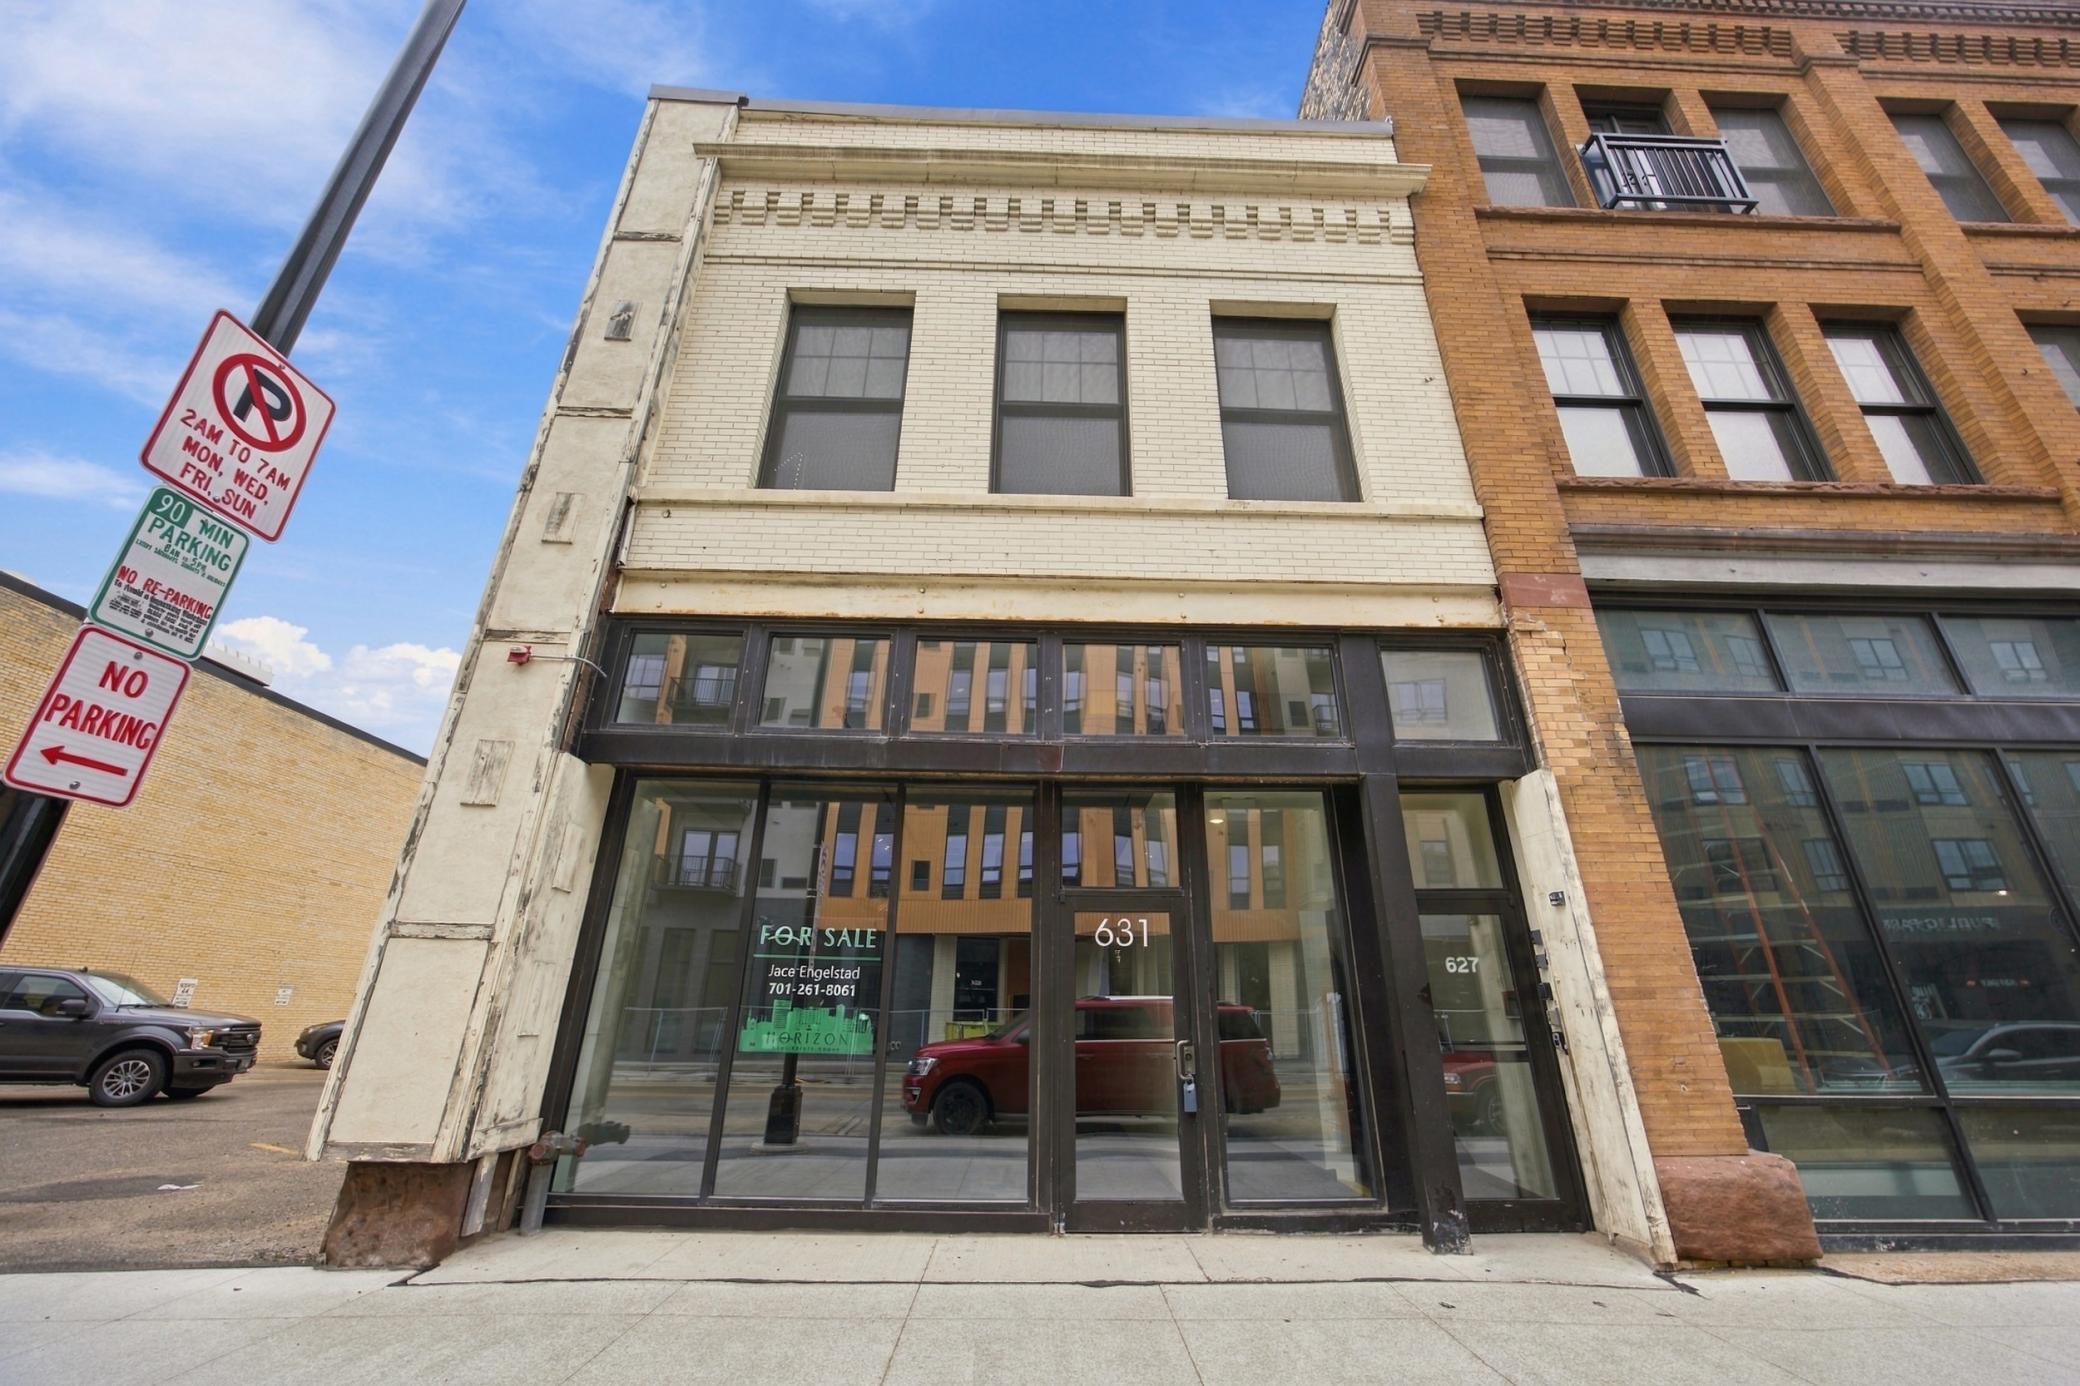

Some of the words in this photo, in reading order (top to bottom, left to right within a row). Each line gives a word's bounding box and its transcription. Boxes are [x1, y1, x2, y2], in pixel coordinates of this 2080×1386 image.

[180, 408, 224, 445] 2AM
[228, 439, 250, 464] TO
[257, 458, 291, 491] 7AM
[182, 436, 225, 477] MON,
[233, 468, 269, 505] WED,
[180, 462, 212, 497] FRI,
[222, 488, 256, 519] SUN
[147, 517, 232, 571] PARKING
[156, 494, 186, 522] 90
[198, 519, 234, 549] MIN
[117, 565, 138, 584] NO
[142, 578, 213, 620] RE-PARKING
[99, 661, 148, 698] NO
[44, 693, 157, 750] PARKING
[760, 925, 812, 946] FOR
[823, 927, 877, 948] SALE
[1095, 918, 1148, 947] 631
[768, 964, 796, 977] Jace
[799, 965, 860, 981] Engelstad
[768, 983, 856, 997] 701-261-8061
[1445, 956, 1479, 973] 627
